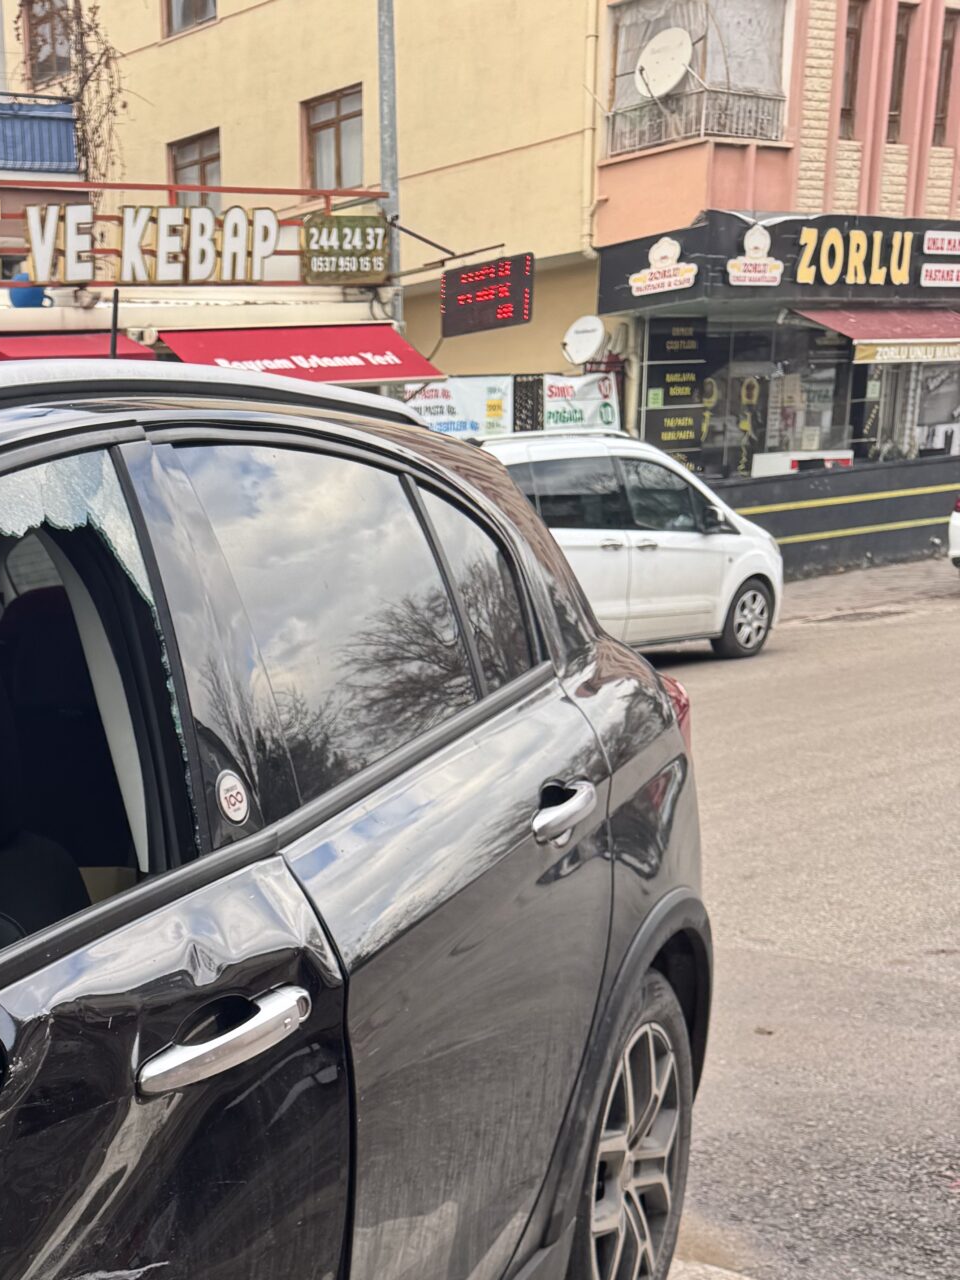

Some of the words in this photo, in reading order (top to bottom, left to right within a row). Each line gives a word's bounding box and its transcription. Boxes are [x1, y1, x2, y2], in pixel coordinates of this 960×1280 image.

[25, 203, 96, 285] VE
[119, 205, 279, 285] KEBAP
[309, 226, 340, 251] 244
[342, 226, 364, 251] 24
[365, 226, 386, 251] 37
[311, 256, 337, 273] 0537
[796, 226, 914, 286] ZORLU
[214, 358, 296, 373] Bayram
[359, 351, 403, 365] Yeri
